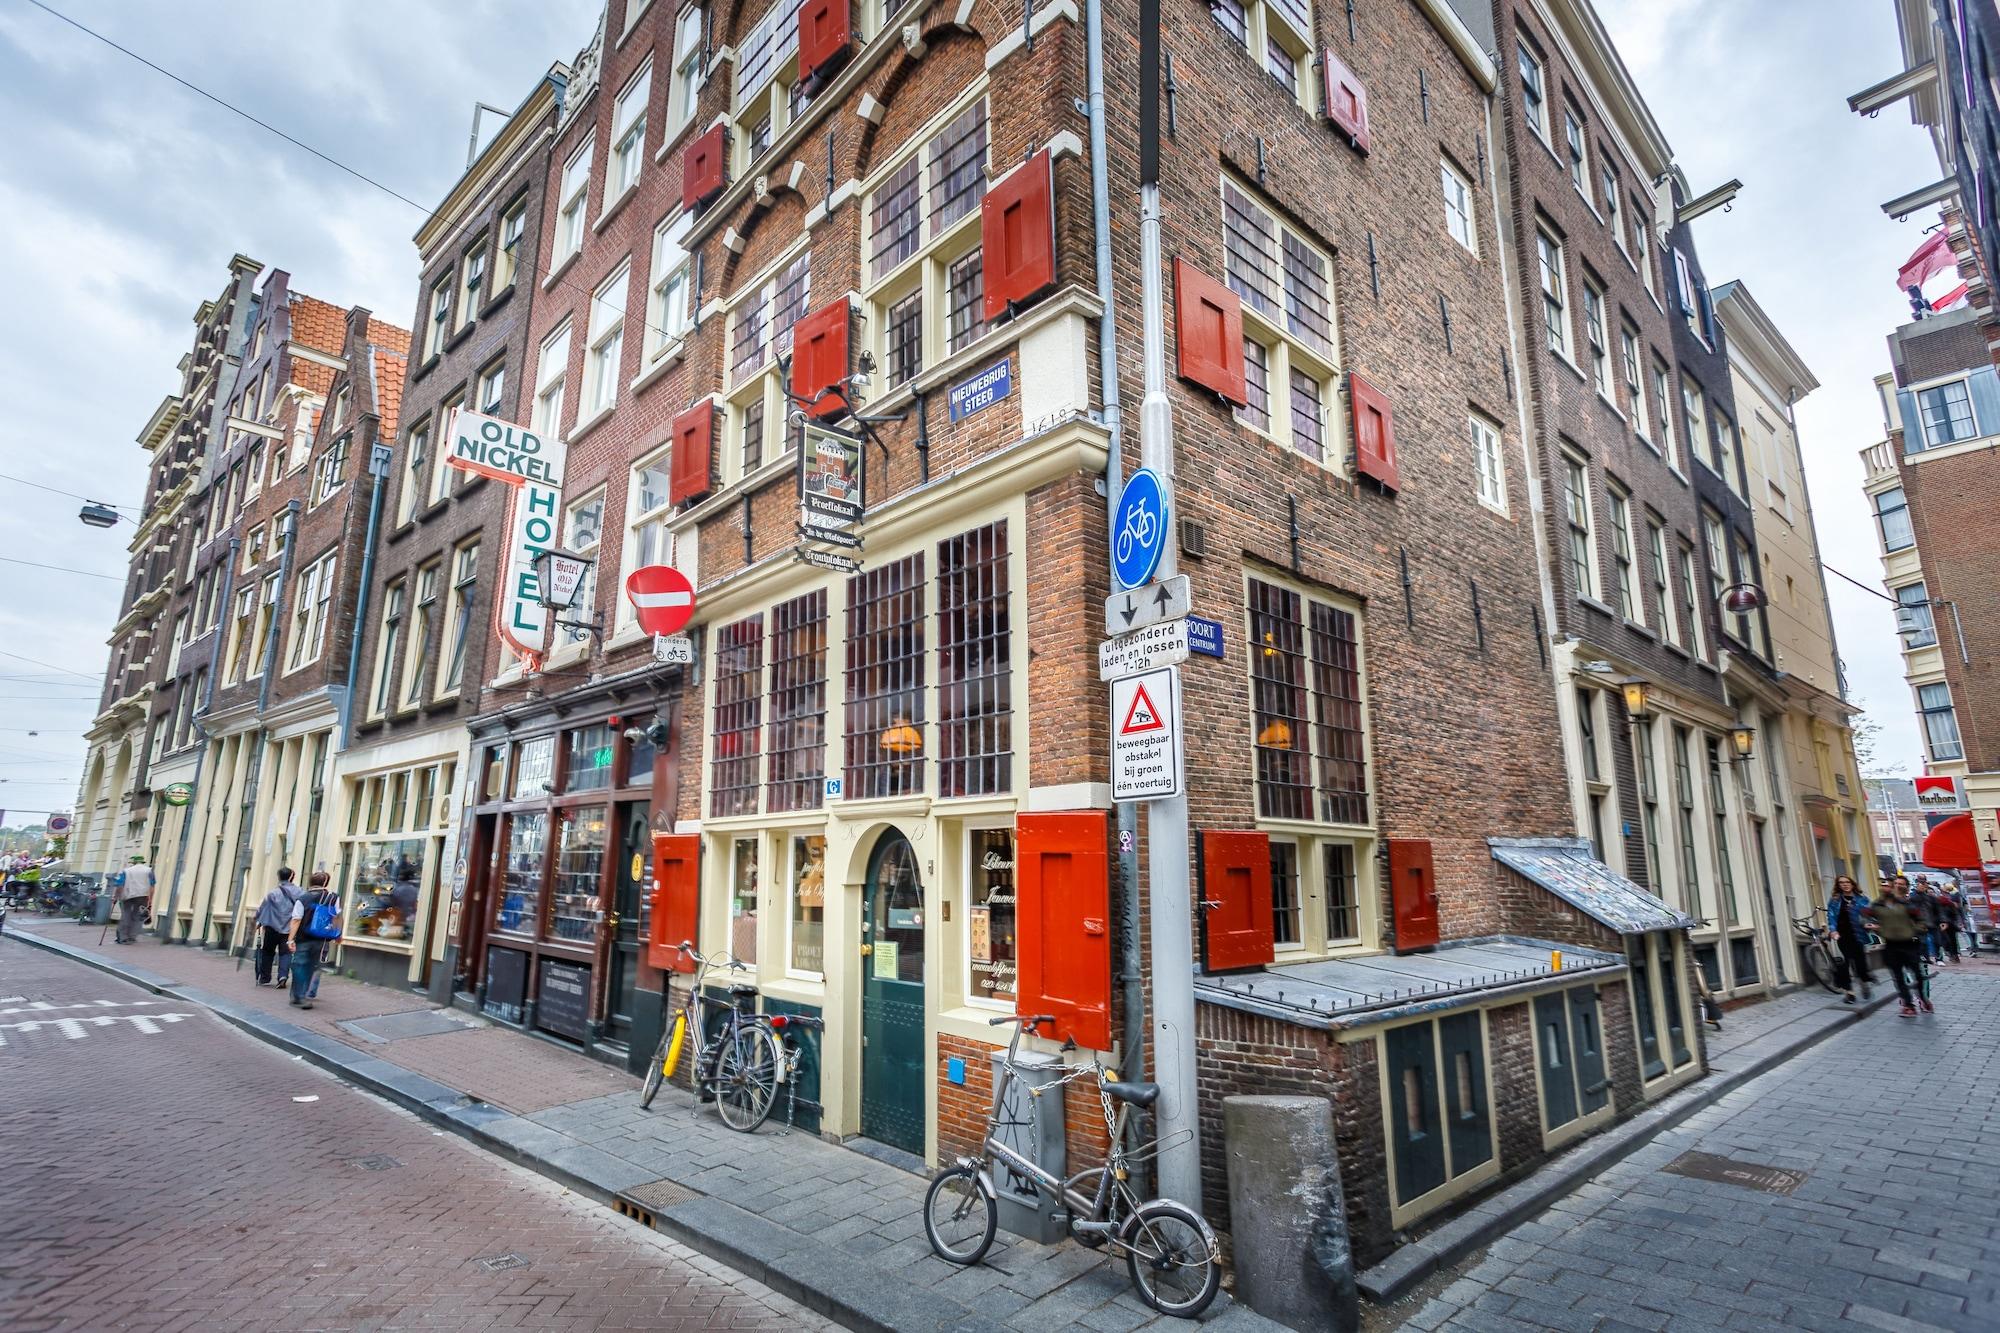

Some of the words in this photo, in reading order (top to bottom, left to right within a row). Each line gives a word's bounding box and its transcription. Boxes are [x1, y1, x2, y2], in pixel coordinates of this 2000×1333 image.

[952, 364, 1007, 404] NIEUWEBRUG
[965, 387, 994, 413] STEEG
[481, 421, 541, 454] OLD
[457, 435, 558, 485] NICKEL
[811, 496, 854, 516] Proeflokaal
[816, 529, 823, 538] de
[514, 487, 555, 631] HOTEL
[556, 559, 579, 576] Hotel
[557, 574, 573, 585] Old
[553, 583, 573, 594] Nickel
[1105, 623, 1176, 654] uitgezonderd
[1189, 637, 1216, 651] CENTRUM
[1101, 652, 1126, 669] laden
[1128, 649, 1140, 660] en
[1143, 637, 1184, 656] lossen
[1123, 656, 1151, 675] 7-12h
[1117, 734, 1170, 750] beweegbaar
[1125, 748, 1162, 762] obstakel
[1124, 764, 1136, 778] bij
[1137, 764, 1163, 778] groen
[1117, 780, 1132, 791] één
[1134, 777, 1172, 791] voertuig
[1918, 792, 1957, 804] Marlboro
